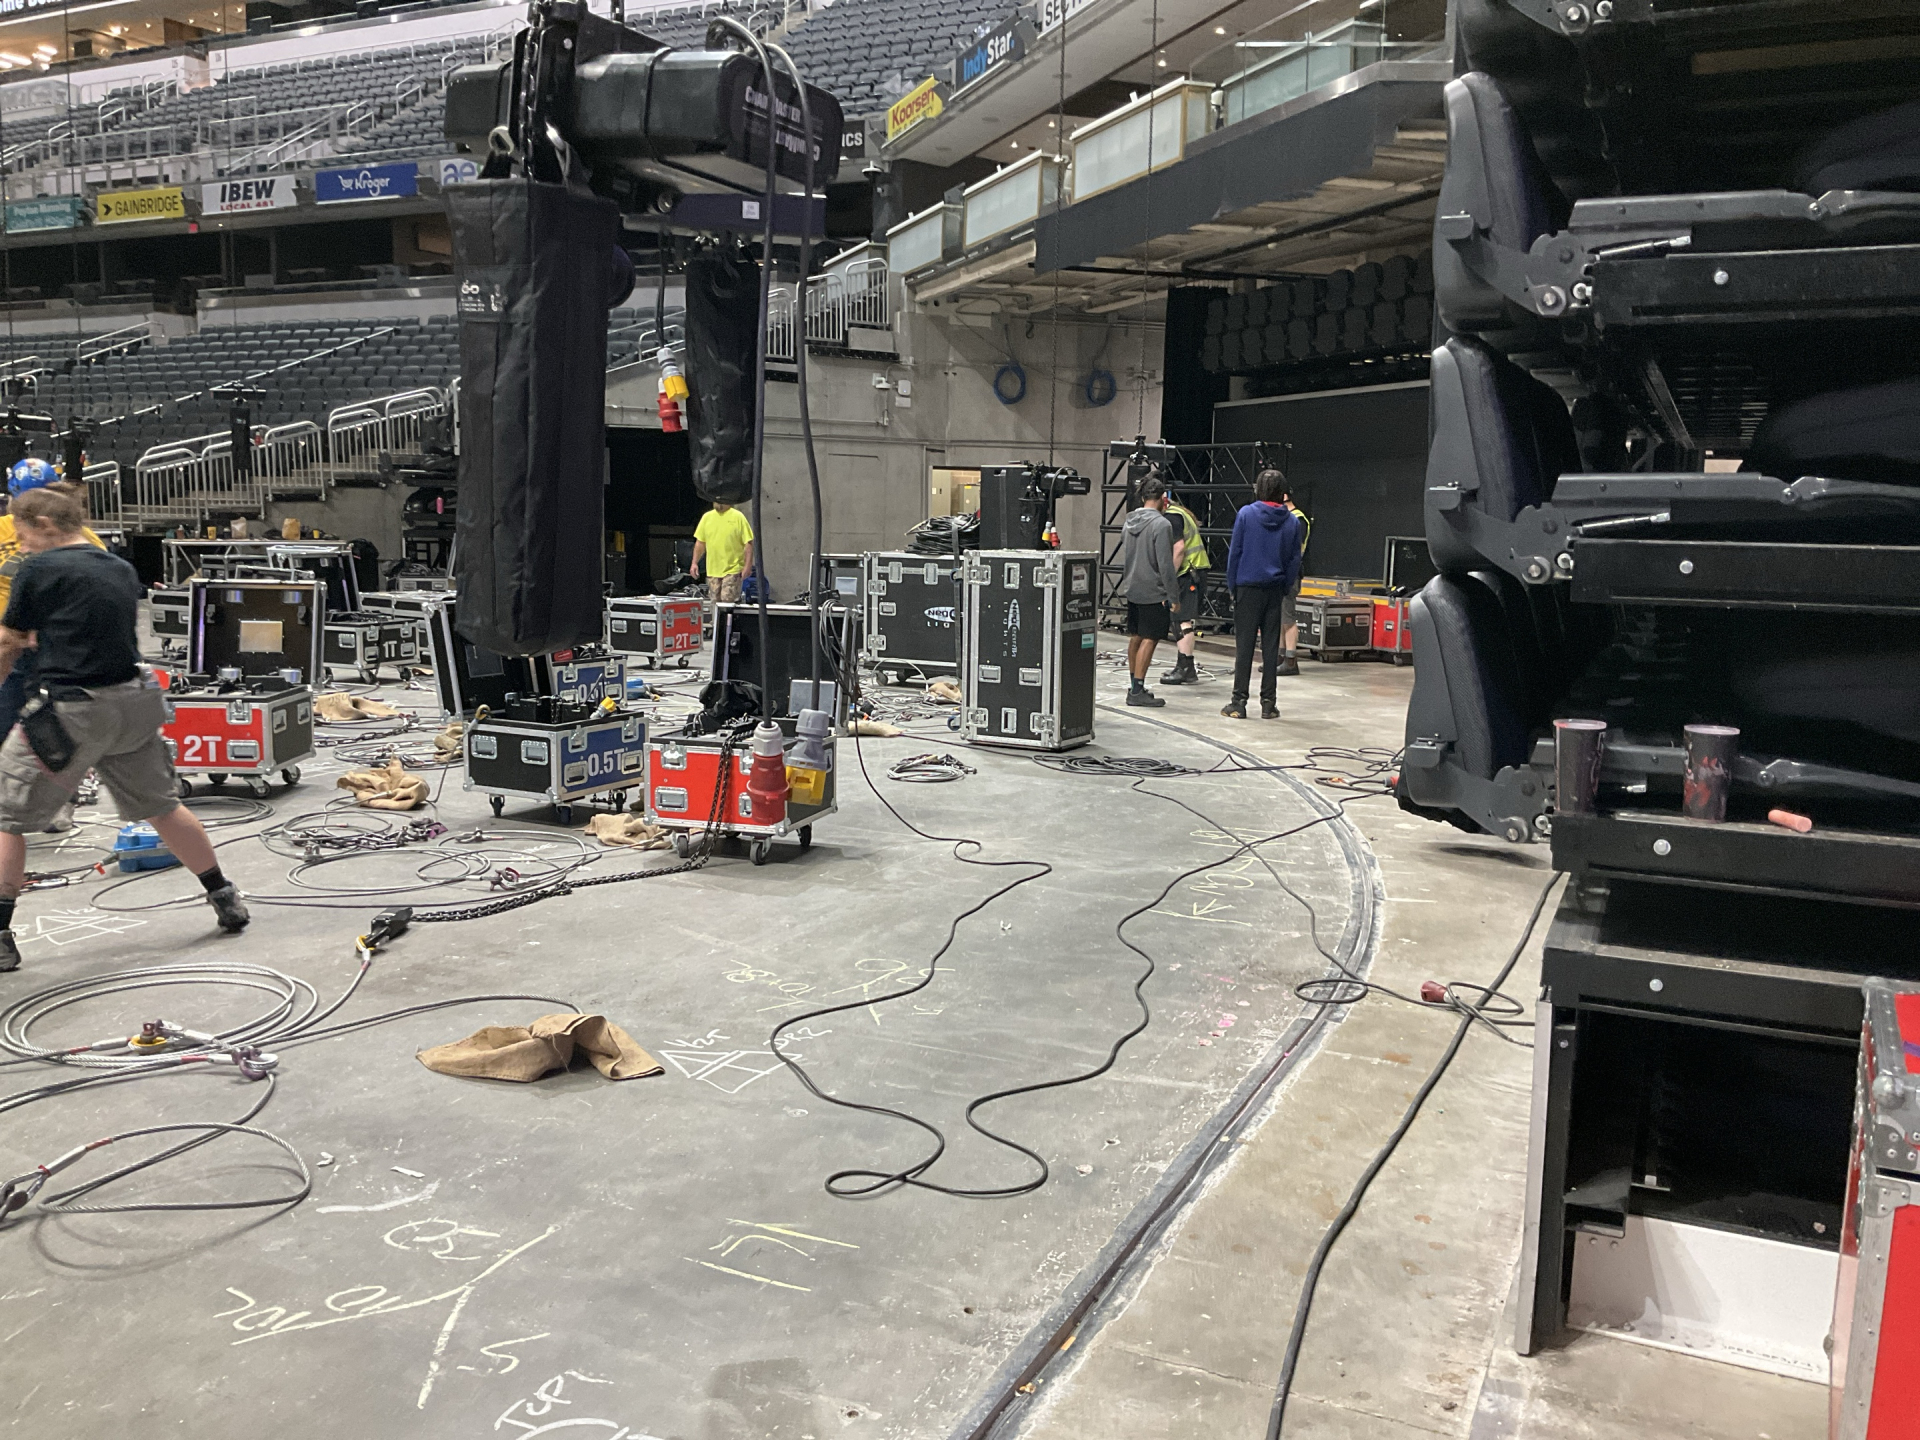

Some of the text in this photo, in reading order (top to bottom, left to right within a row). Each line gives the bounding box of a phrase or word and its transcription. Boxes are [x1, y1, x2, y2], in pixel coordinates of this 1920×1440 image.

[892, 87, 934, 130] Koorsen
[220, 179, 275, 203] IBEW
[355, 170, 390, 196] Kroger
[115, 195, 179, 217] GAINBRIDGE
[220, 202, 253, 211] LOCAL
[383, 640, 398, 658] 1T
[675, 632, 689, 649] 2T
[183, 735, 222, 762] 2T
[587, 749, 625, 777] 0.5T
